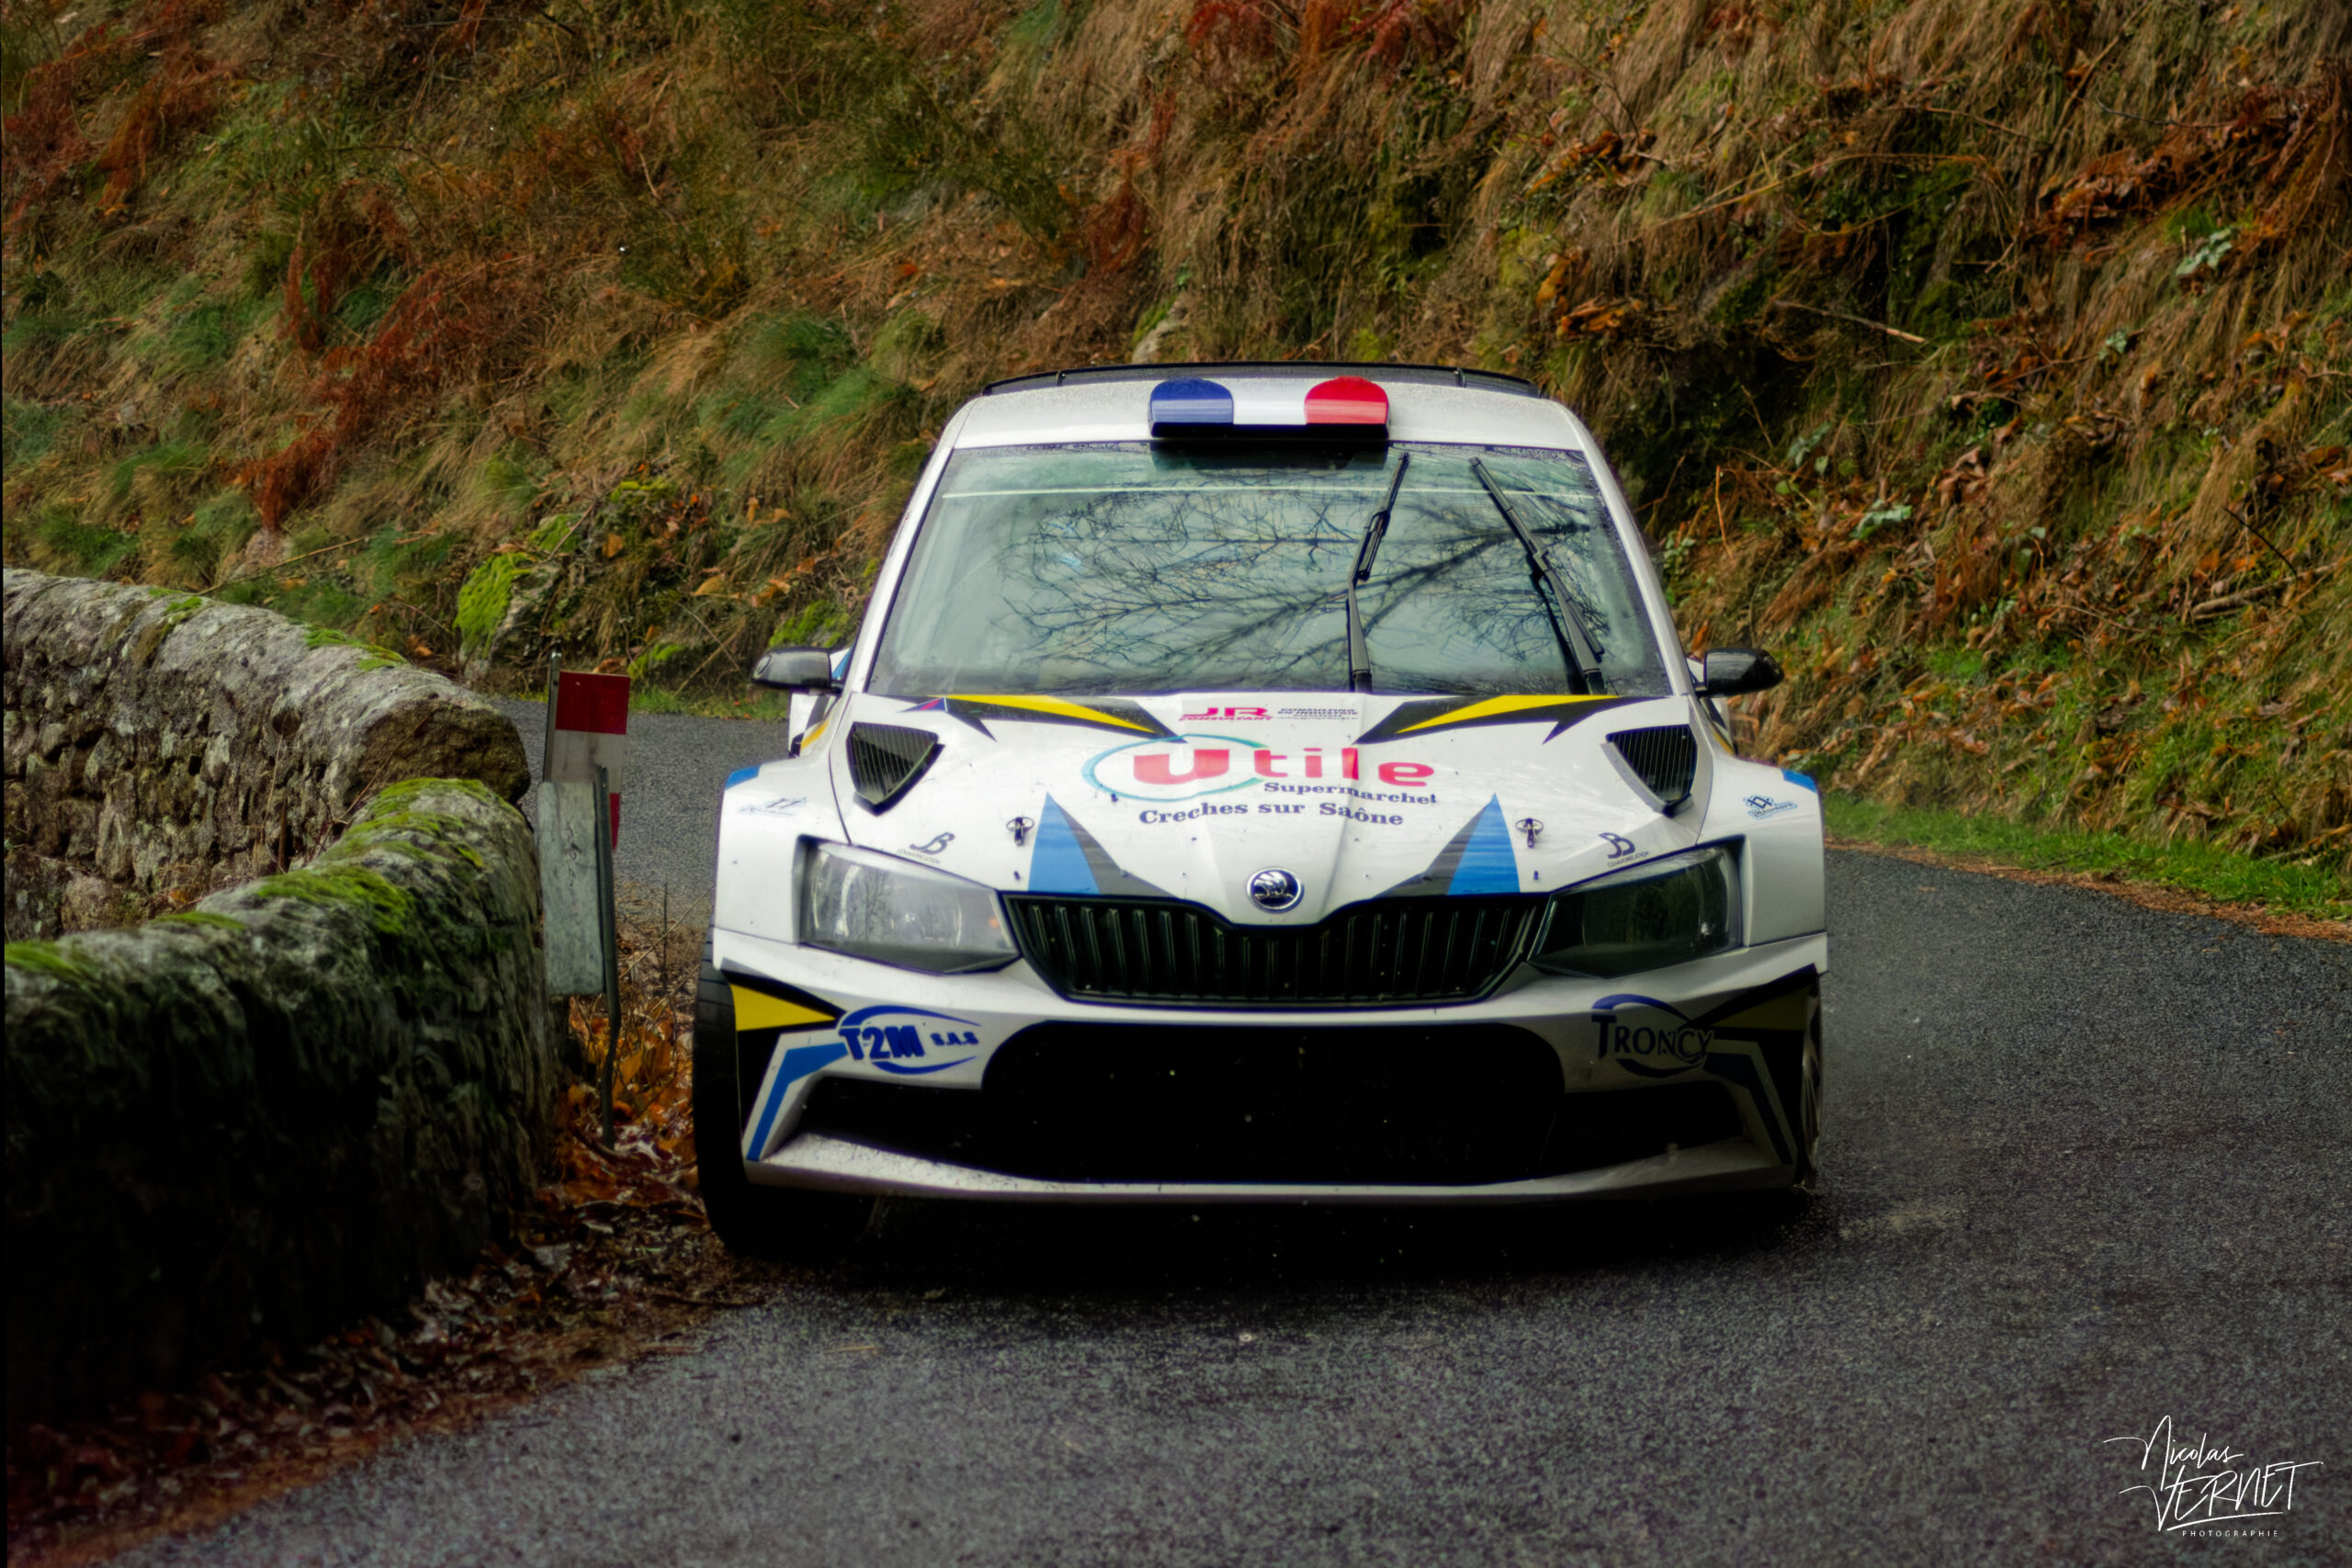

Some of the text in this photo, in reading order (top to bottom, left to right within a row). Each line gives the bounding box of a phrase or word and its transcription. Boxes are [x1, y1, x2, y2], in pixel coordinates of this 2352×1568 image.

[1182, 707, 1268, 717] JR
[1139, 802, 1404, 826] Creches sur Saône
[838, 1025, 925, 1060] T2M
[1591, 1014, 1714, 1063] TRONCY
